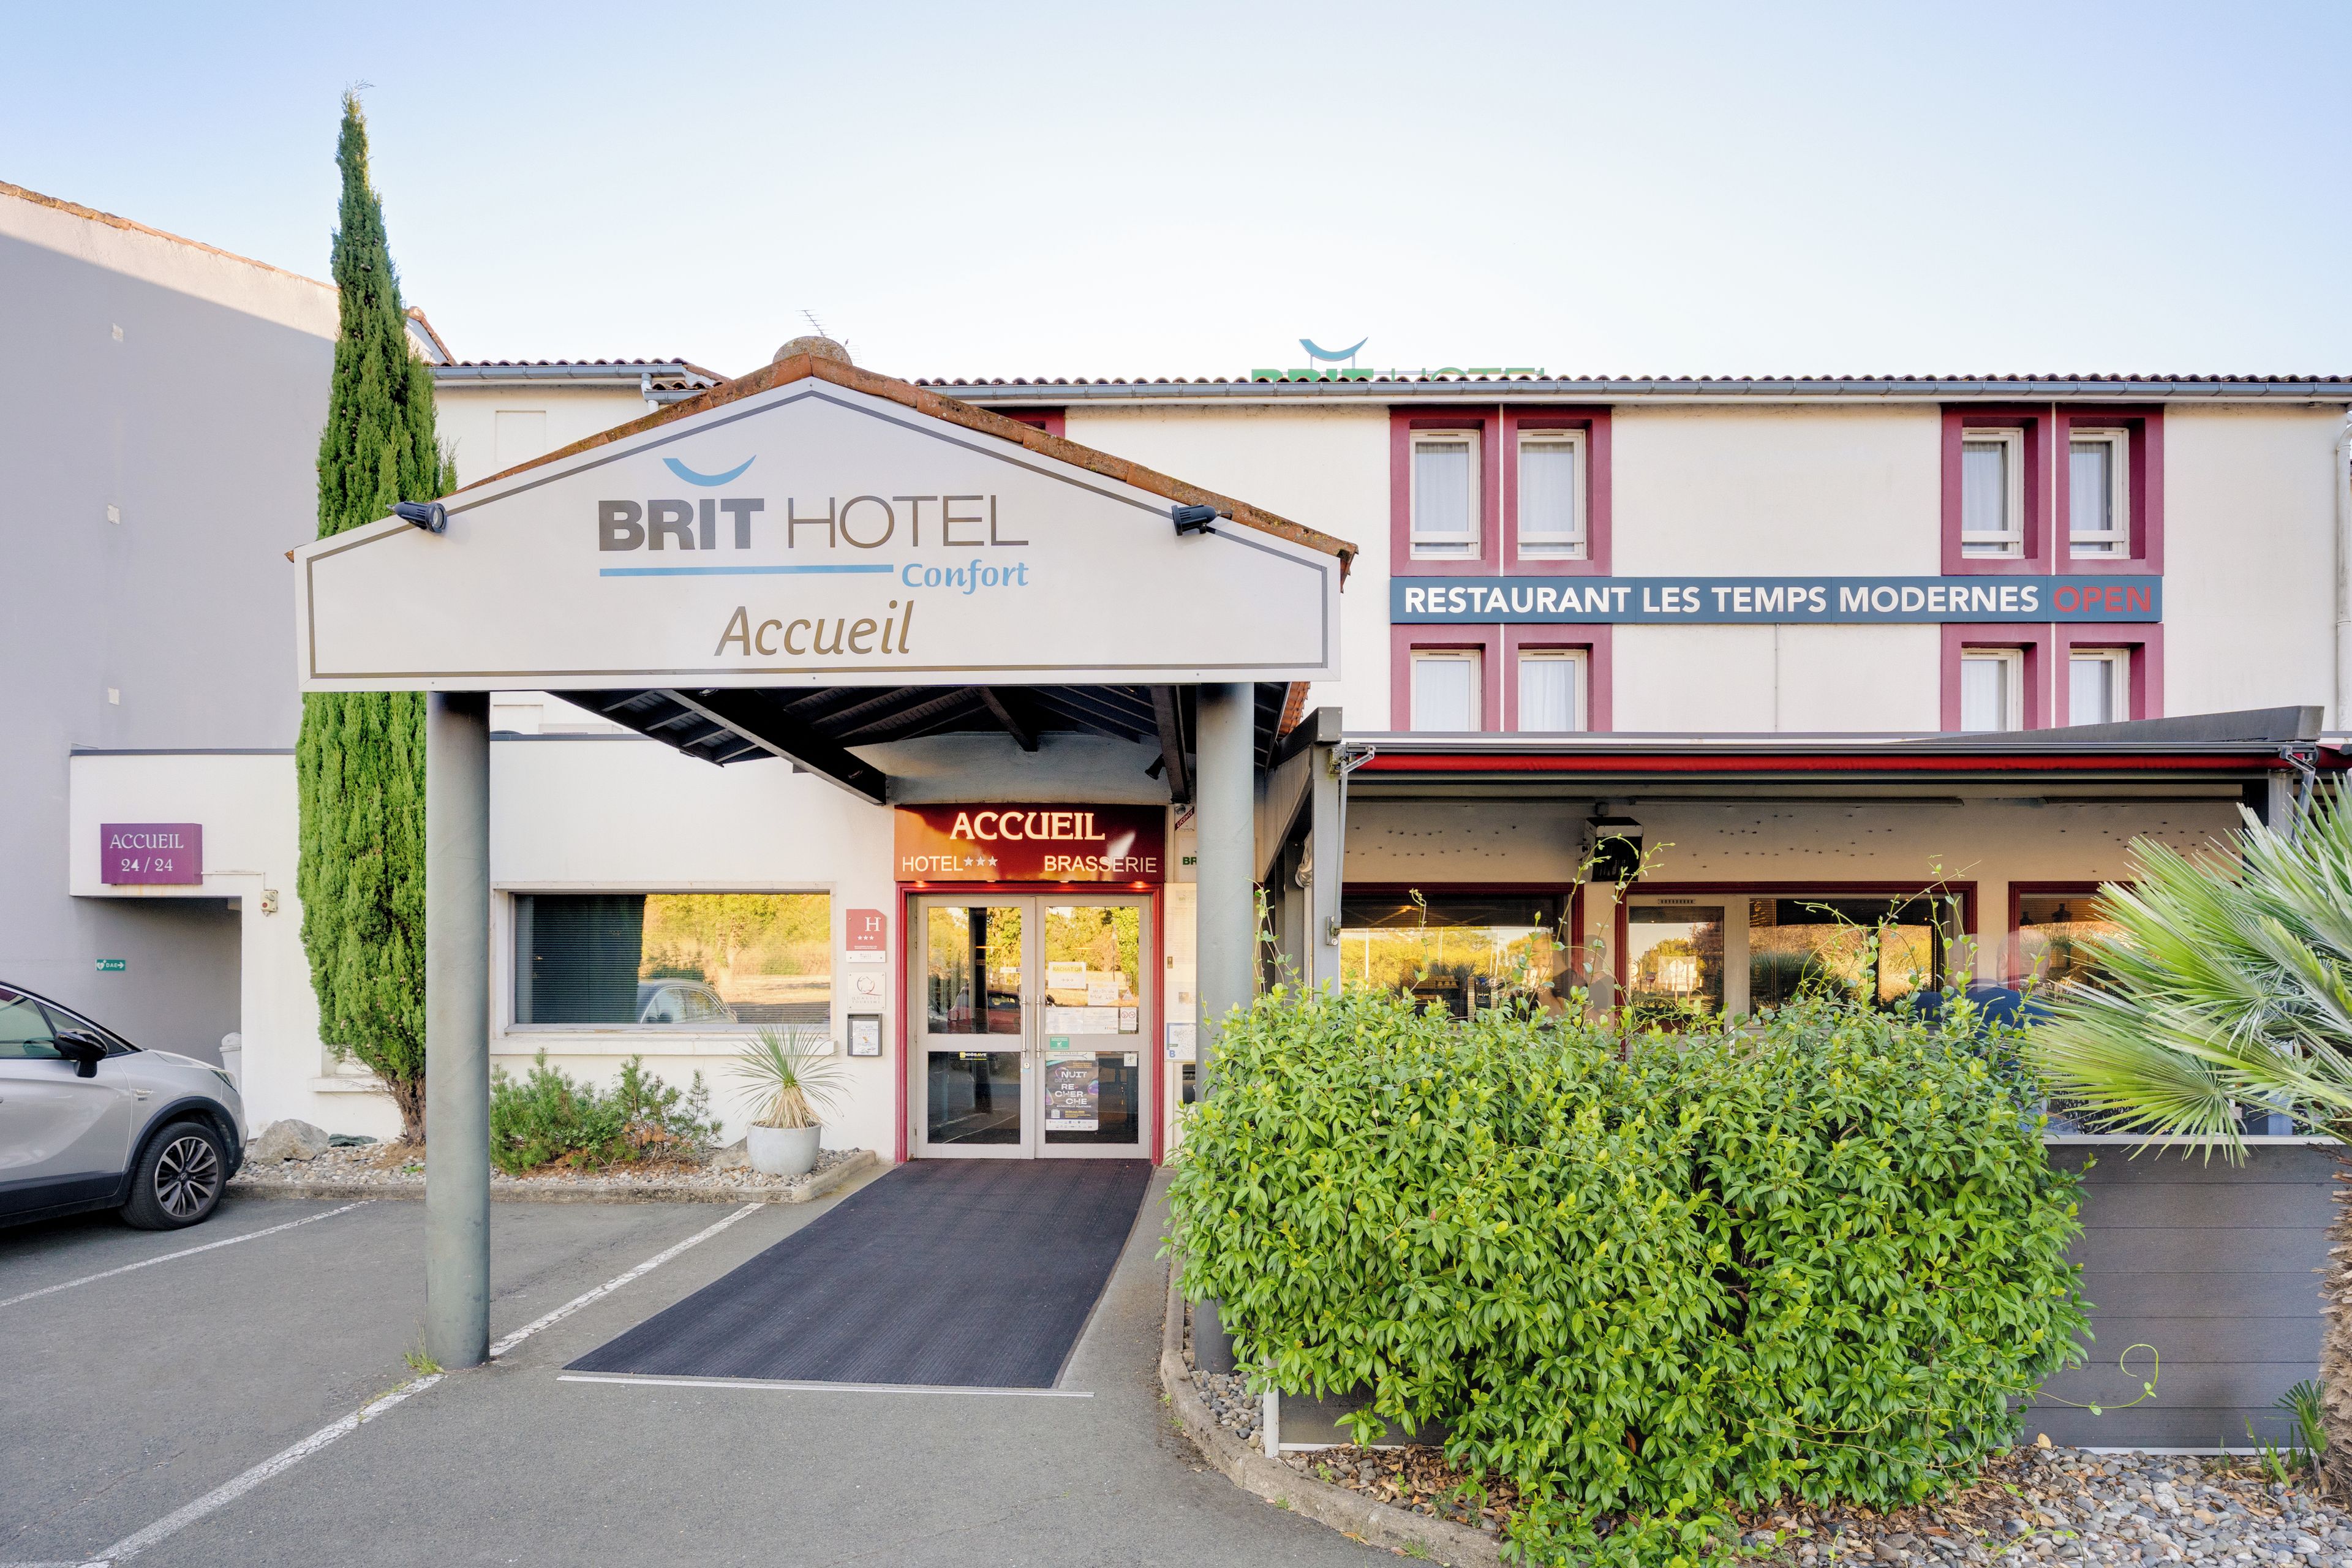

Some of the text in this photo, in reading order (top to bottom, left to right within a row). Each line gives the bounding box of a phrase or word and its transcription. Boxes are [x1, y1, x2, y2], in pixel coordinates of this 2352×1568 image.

[598, 494, 1029, 551] BRIT HOTEL
[902, 559, 1029, 595] Confort
[1404, 586, 2151, 613] RESTAURANT LES TEMPS MODERNES OPEN
[714, 600, 915, 656] Accueil
[949, 811, 1105, 840] ACCUEIL
[1177, 809, 1193, 827] LICENCE
[110, 834, 184, 849] ACCUEIL
[902, 855, 1157, 873] HOTEL BRASSERIE
[865, 917, 881, 932] H
